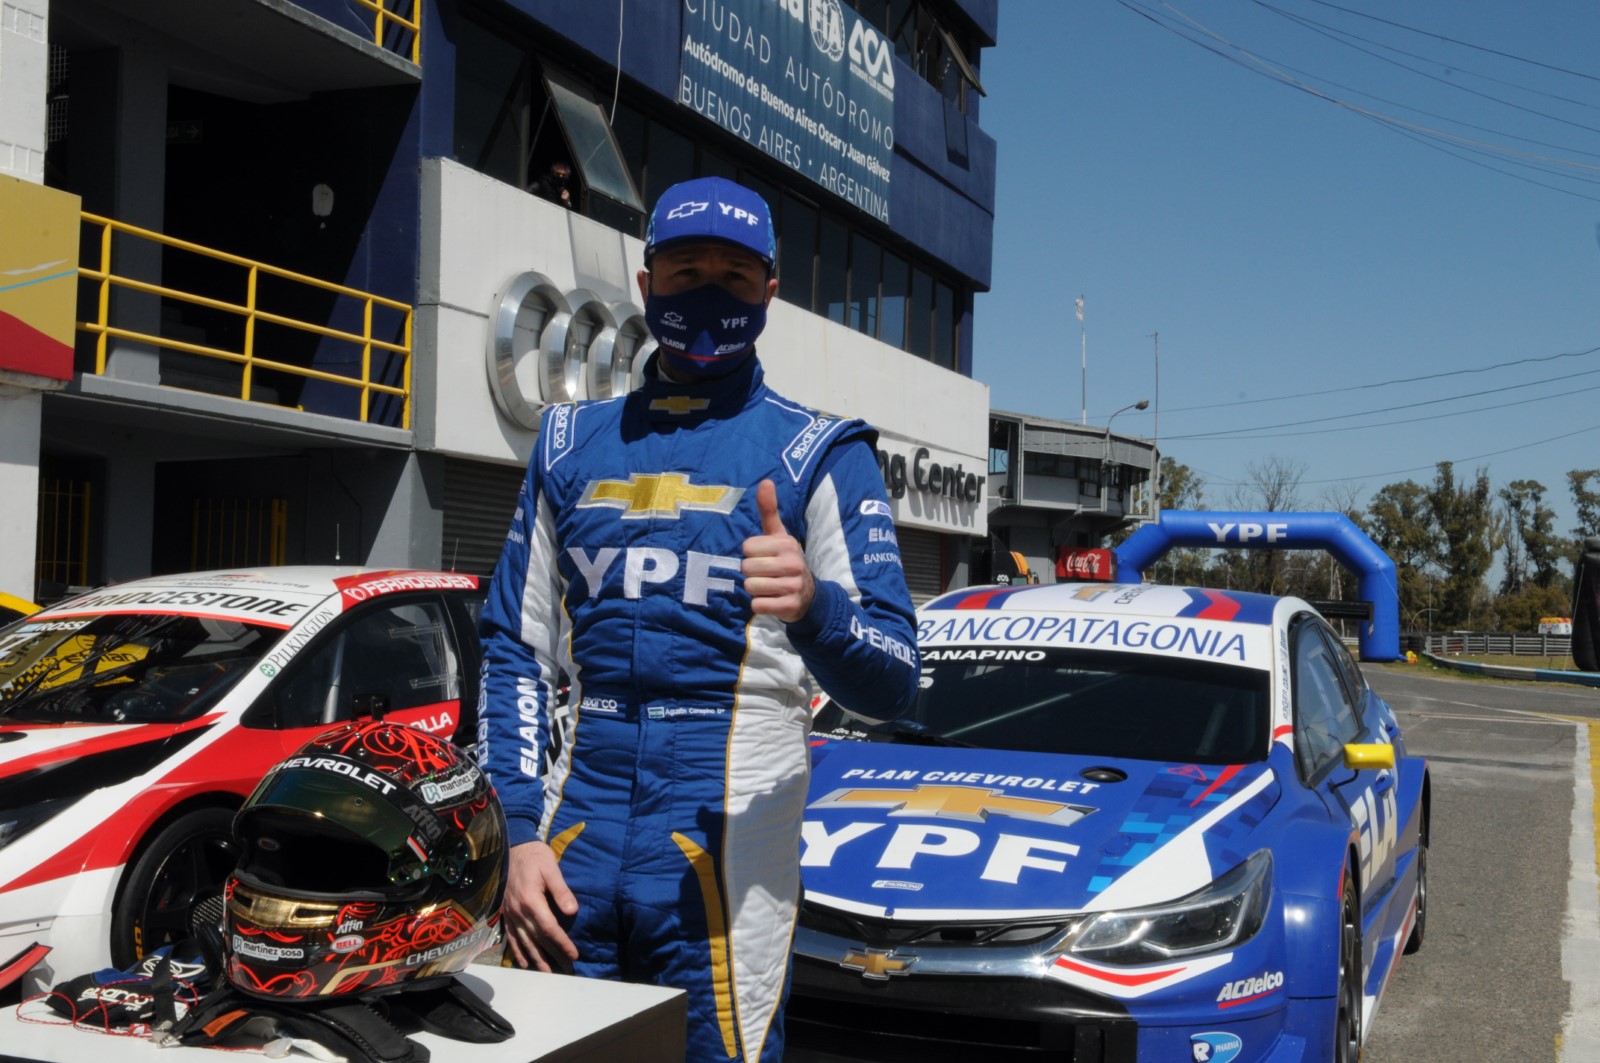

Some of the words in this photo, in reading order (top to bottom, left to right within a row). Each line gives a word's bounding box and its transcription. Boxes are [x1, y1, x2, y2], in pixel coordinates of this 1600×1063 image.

[684, 34, 745, 88] Autódromo
[746, 76, 759, 97] de
[761, 83, 796, 120] Buenos
[795, 107, 817, 135] Aires
[818, 123, 841, 150] Oscar
[840, 141, 847, 157] y
[847, 143, 865, 167] Juan
[866, 155, 890, 182] Gálvez
[785, 56, 894, 150] AUTÓDROMO
[682, 74, 751, 140] BUENOS
[759, 125, 801, 169] AIRES
[820, 163, 889, 222] ARGENTINA
[718, 202, 759, 226] YPF
[721, 316, 748, 330] YPF
[554, 404, 571, 450] sparco
[790, 418, 831, 460] sparco
[911, 447, 986, 504] Center
[1208, 523, 1288, 543] YPF
[358, 575, 477, 597] FERROSIDER
[566, 547, 741, 607] YPF
[52, 590, 311, 618] BRIDGESTONE
[269, 608, 335, 669] PILKINGTON
[916, 616, 1246, 662] BANCOPATAGONIA
[516, 677, 539, 778] ELAION
[268, 757, 397, 795] CHEVROLET
[841, 768, 919, 781] PLAN
[922, 769, 1100, 795] CHEVROLET
[800, 821, 1080, 884] YPF
[281, 948, 302, 957] sosa
[335, 939, 359, 950] BELL
[406, 931, 484, 966] CHEVROLET
[1216, 971, 1284, 1002] ACDelco
[1193, 1042, 1210, 1062] R
